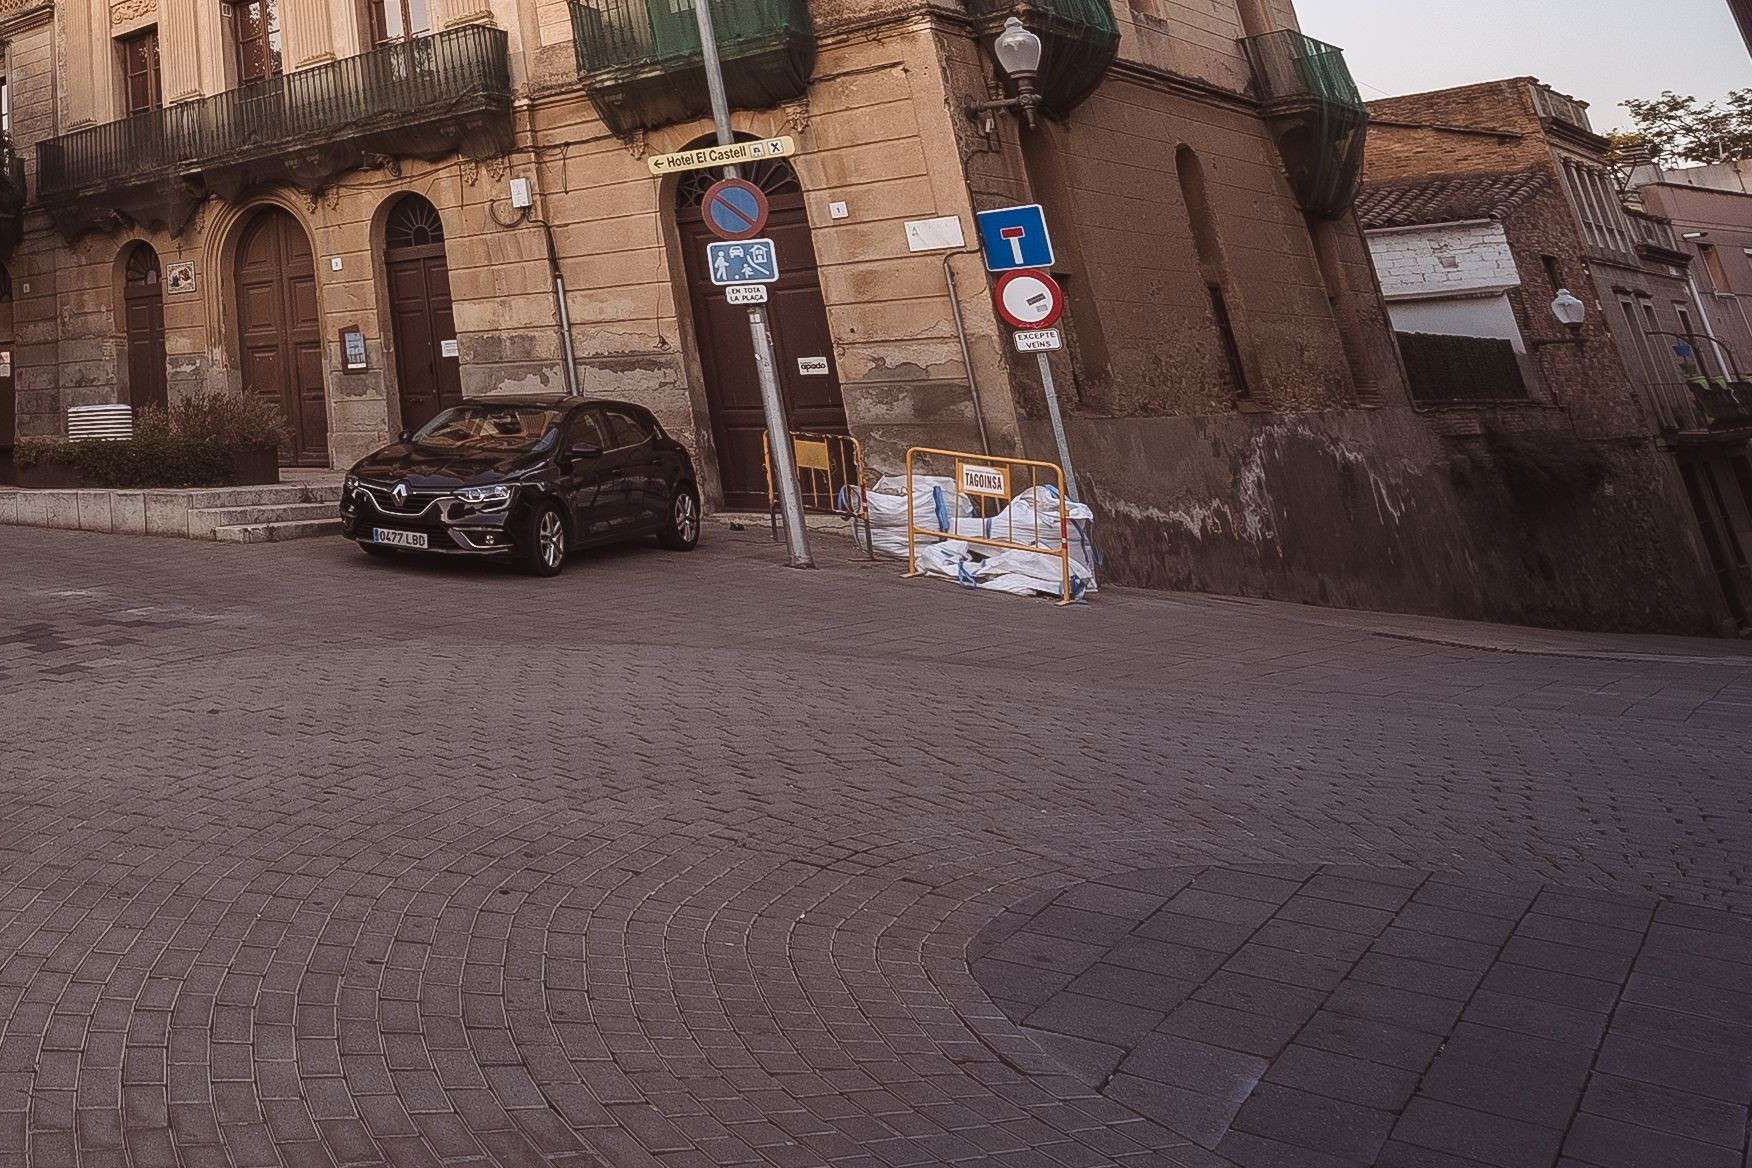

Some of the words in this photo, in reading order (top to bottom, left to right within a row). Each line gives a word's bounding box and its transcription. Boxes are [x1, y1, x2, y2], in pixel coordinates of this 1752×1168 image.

[666, 153, 694, 168] Hotel
[696, 151, 707, 164] El
[709, 145, 747, 162] Castell
[742, 294, 764, 302] PLAÇA
[1017, 331, 1057, 341] EXCEPTE
[965, 472, 1003, 491] TAGOINSA
[380, 530, 404, 543] 0477
[405, 533, 426, 547] LBD
